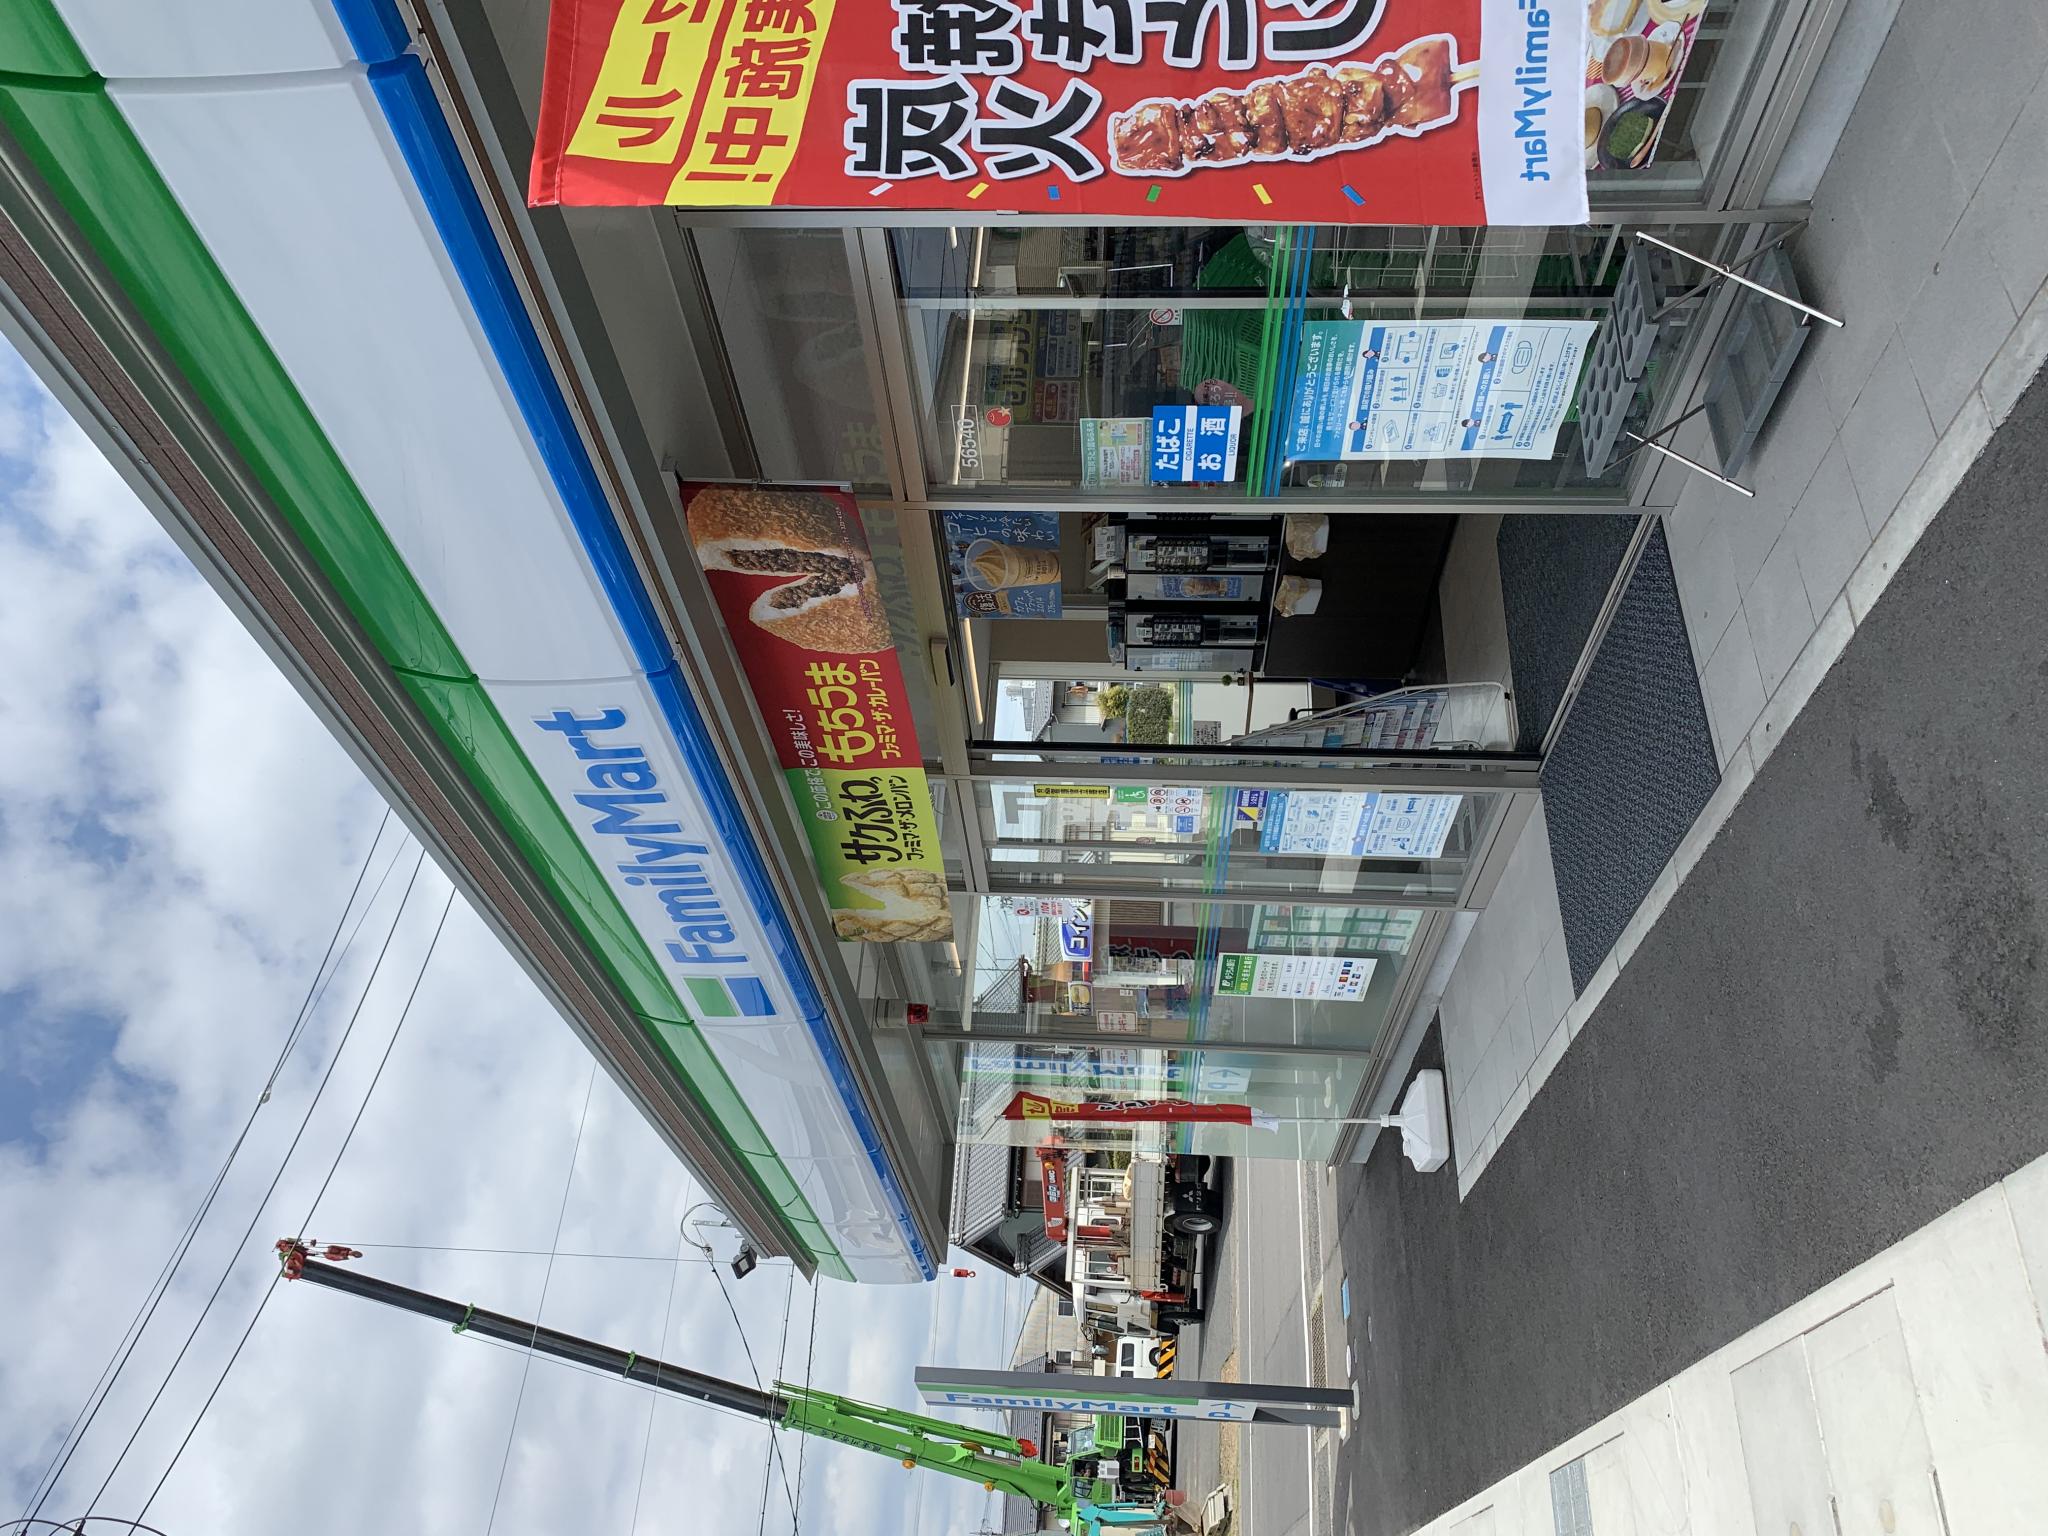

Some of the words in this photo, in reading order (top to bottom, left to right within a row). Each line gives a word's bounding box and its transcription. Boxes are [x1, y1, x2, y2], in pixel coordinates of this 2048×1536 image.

[956, 418, 979, 468] 56540
[1155, 418, 1180, 470] たばこ
[1185, 428, 1194, 461] CIGARETTE
[1227, 433, 1237, 456] LIQUOR
[804, 662, 876, 763] もちうま
[533, 708, 748, 963] FamilyMart
[838, 776, 902, 865] サクふわっ
[945, 1393, 1178, 1415] FamilyMart
